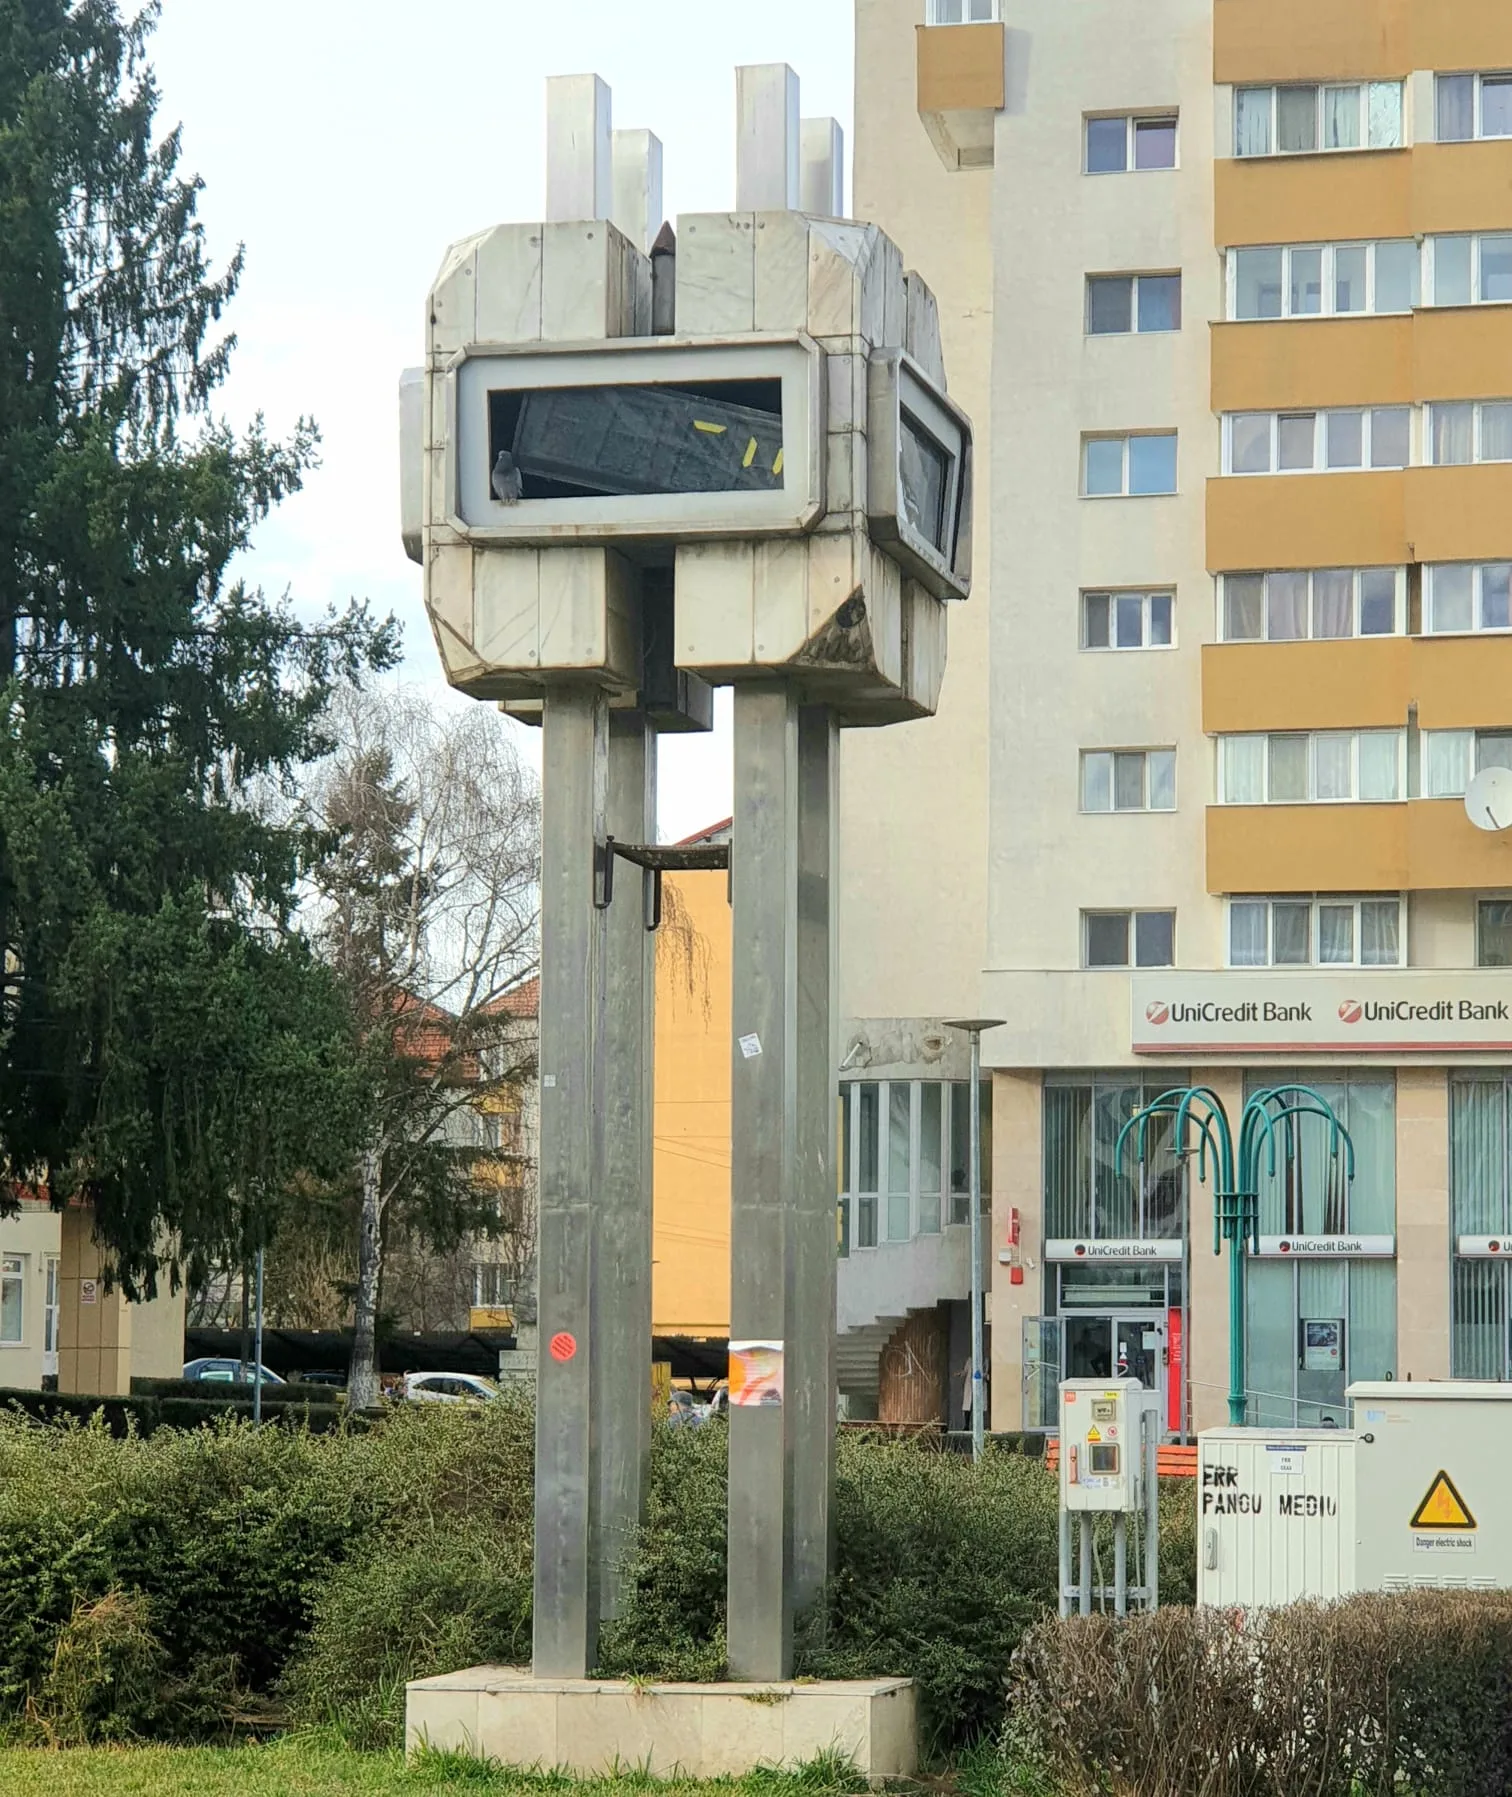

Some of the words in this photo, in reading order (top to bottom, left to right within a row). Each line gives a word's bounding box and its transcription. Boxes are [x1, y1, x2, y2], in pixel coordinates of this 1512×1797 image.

[1171, 1002, 1258, 1022] UniCredit
[1263, 1002, 1312, 1021] Bank
[1364, 1000, 1453, 1020] UniCredit
[1459, 1000, 1509, 1020] Bank
[1088, 1245, 1130, 1255] UniCredit
[1133, 1245, 1157, 1255] Bank
[1292, 1241, 1335, 1251] UniCredit
[1338, 1241, 1362, 1251] Bank
[1279, 1495, 1337, 1517] MEDIU
[1416, 1536, 1435, 1549] Danger
[1436, 1537, 1455, 1547] electric
[1457, 1537, 1472, 1547] shock
